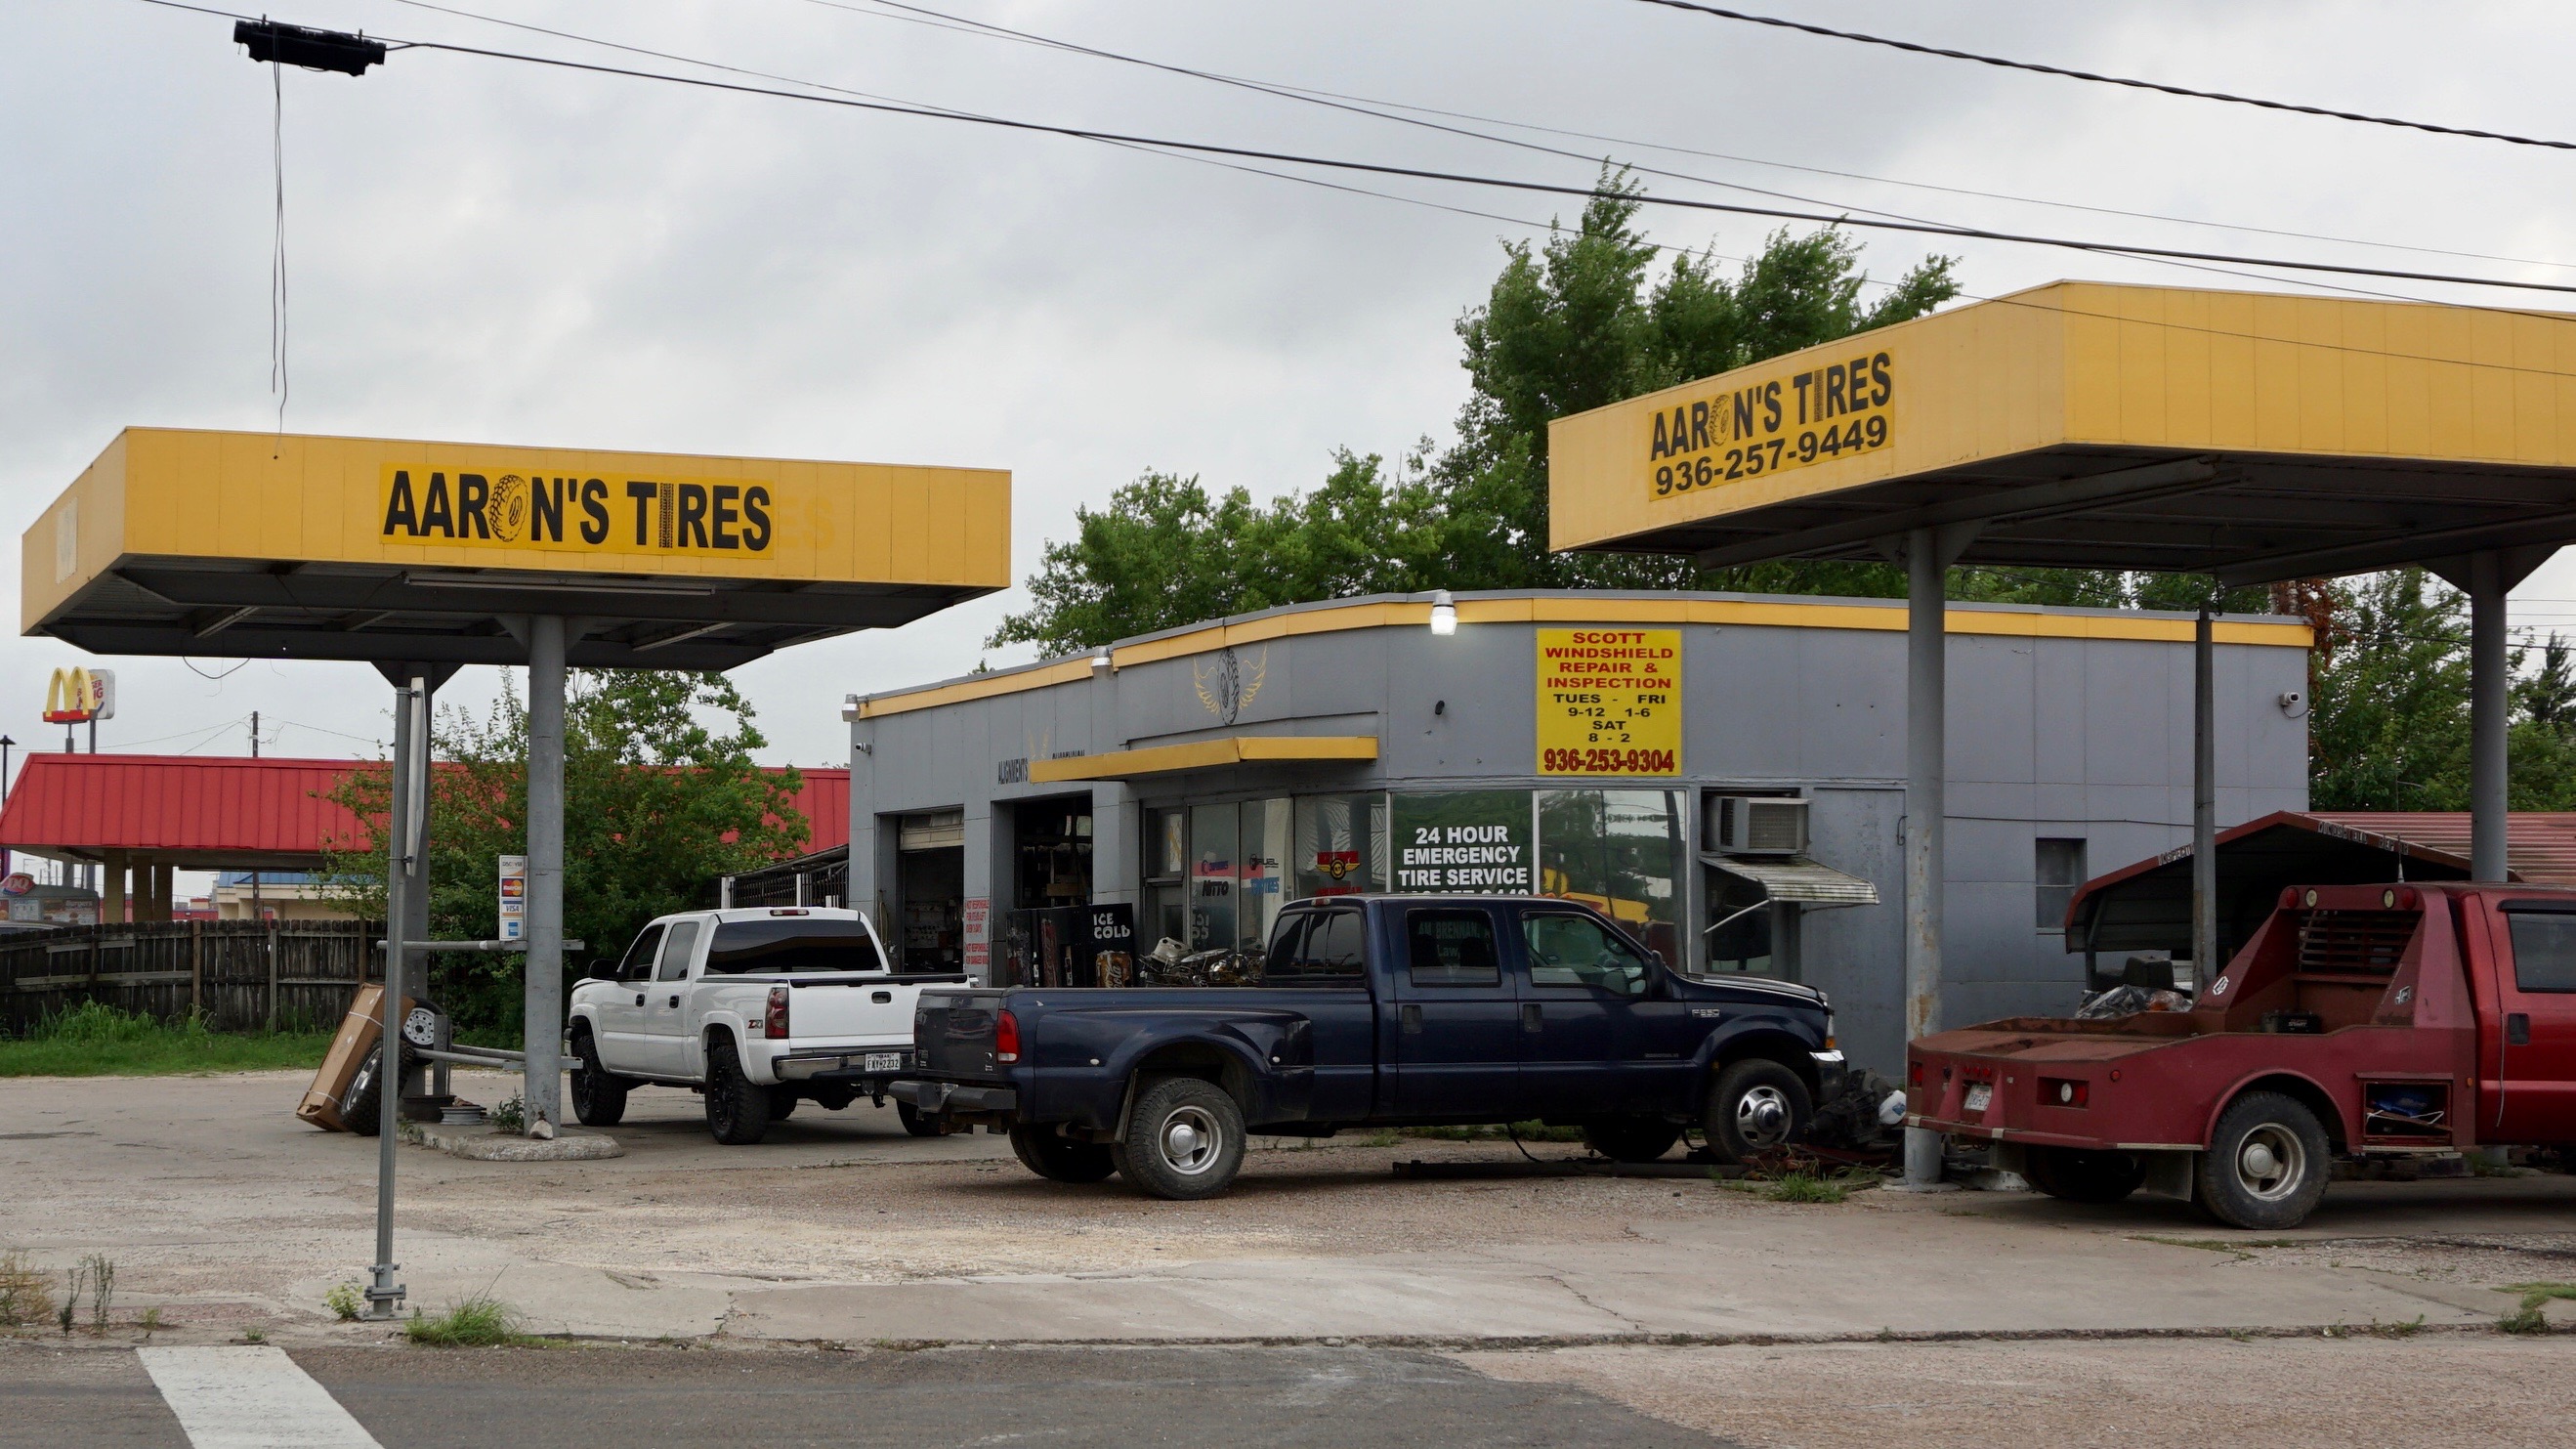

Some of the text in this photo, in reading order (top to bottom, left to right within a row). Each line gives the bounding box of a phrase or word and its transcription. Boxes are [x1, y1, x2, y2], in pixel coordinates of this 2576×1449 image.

[1651, 352, 1892, 462] AARON'S TIRES
[1655, 414, 1887, 495] 936-257-9449
[383, 470, 772, 551] AARON'S TIRES
[1572, 632, 1646, 644] SCOTT
[1544, 647, 1673, 659] WINDSHIELD
[1559, 661, 1658, 673] REPAIR &
[1546, 677, 1671, 689] INSPECTION
[1552, 693, 1601, 703] TUES
[1637, 694, 1667, 704] FRI
[1567, 706, 1651, 718] 9-12 1-6
[1591, 720, 1626, 731] SAT
[1587, 733, 1598, 743] 8
[1620, 733, 1630, 743] 2
[1543, 747, 1675, 773] 936-253-9304
[1415, 826, 1509, 844] 24 HOUR
[1403, 845, 1521, 866] EMERGENCY
[1398, 867, 1528, 887] TIRE SERVICE
[1202, 879, 1230, 897] NITTO
[1092, 912, 1115, 926] ICE
[1093, 924, 1131, 940] COLD
